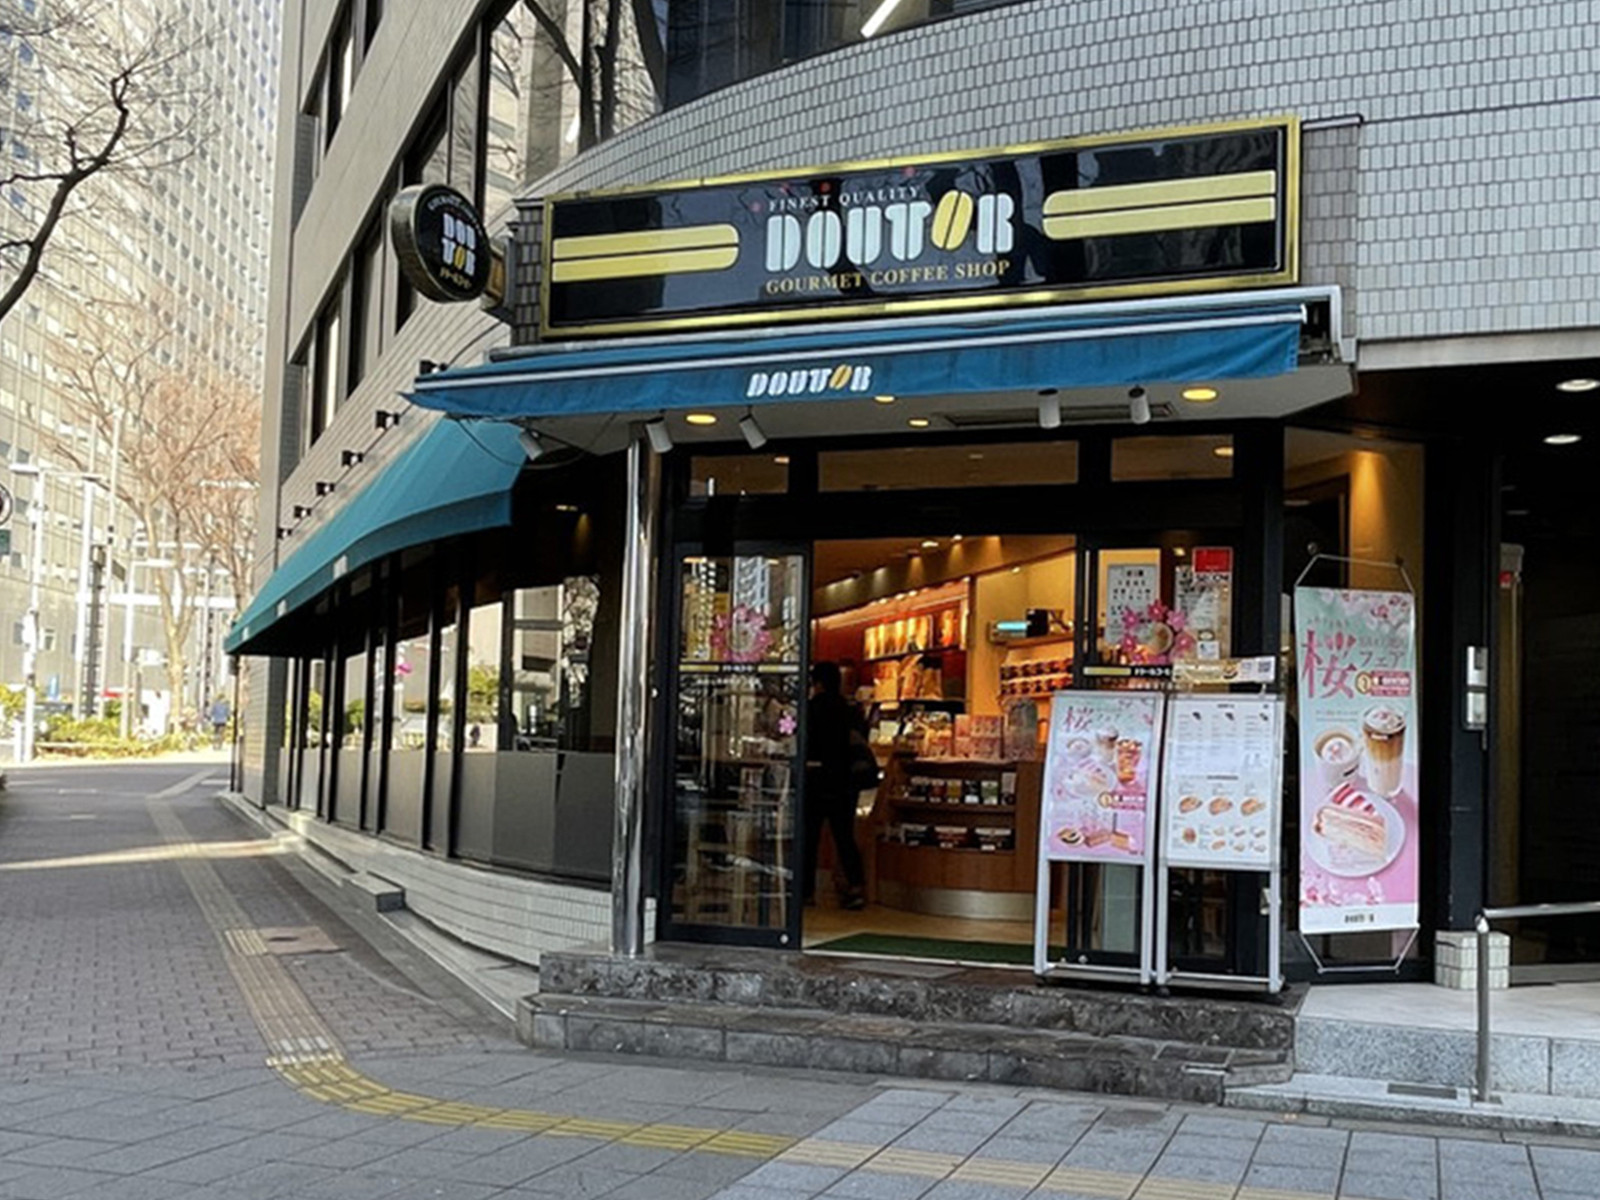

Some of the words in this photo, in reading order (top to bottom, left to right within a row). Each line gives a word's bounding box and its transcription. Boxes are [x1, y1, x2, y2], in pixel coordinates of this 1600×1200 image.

[768, 194, 831, 212] FINEST
[838, 186, 921, 207] QUALITY
[765, 189, 1015, 272] DOUTOR
[766, 272, 863, 294] GOURMET
[870, 265, 949, 286] COFFEE
[954, 259, 1011, 280] SHOP
[746, 364, 872, 397] DOUTOR
[1301, 629, 1357, 699] 桜
